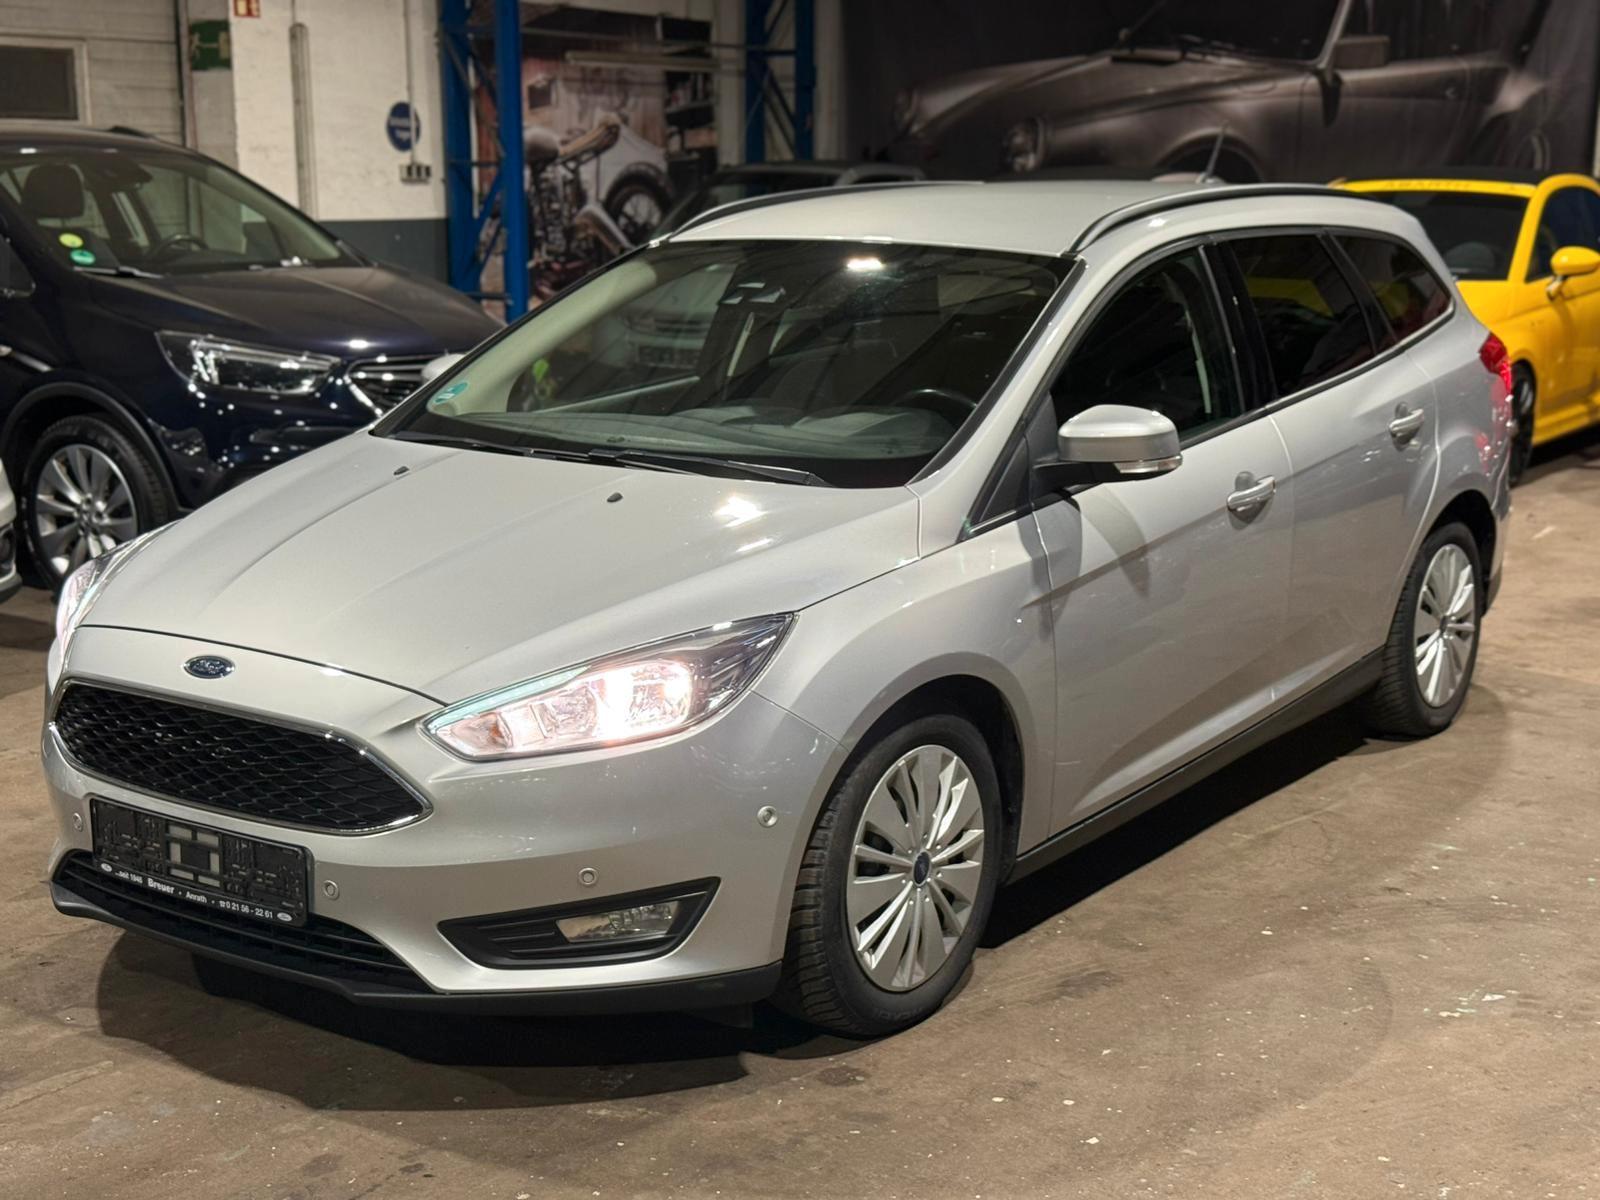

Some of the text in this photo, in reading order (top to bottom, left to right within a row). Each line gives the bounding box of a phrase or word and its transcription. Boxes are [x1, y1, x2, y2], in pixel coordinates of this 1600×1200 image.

[147, 877, 175, 894] Breuer
[185, 891, 208, 903] Anrath
[255, 908, 264, 917] 22
